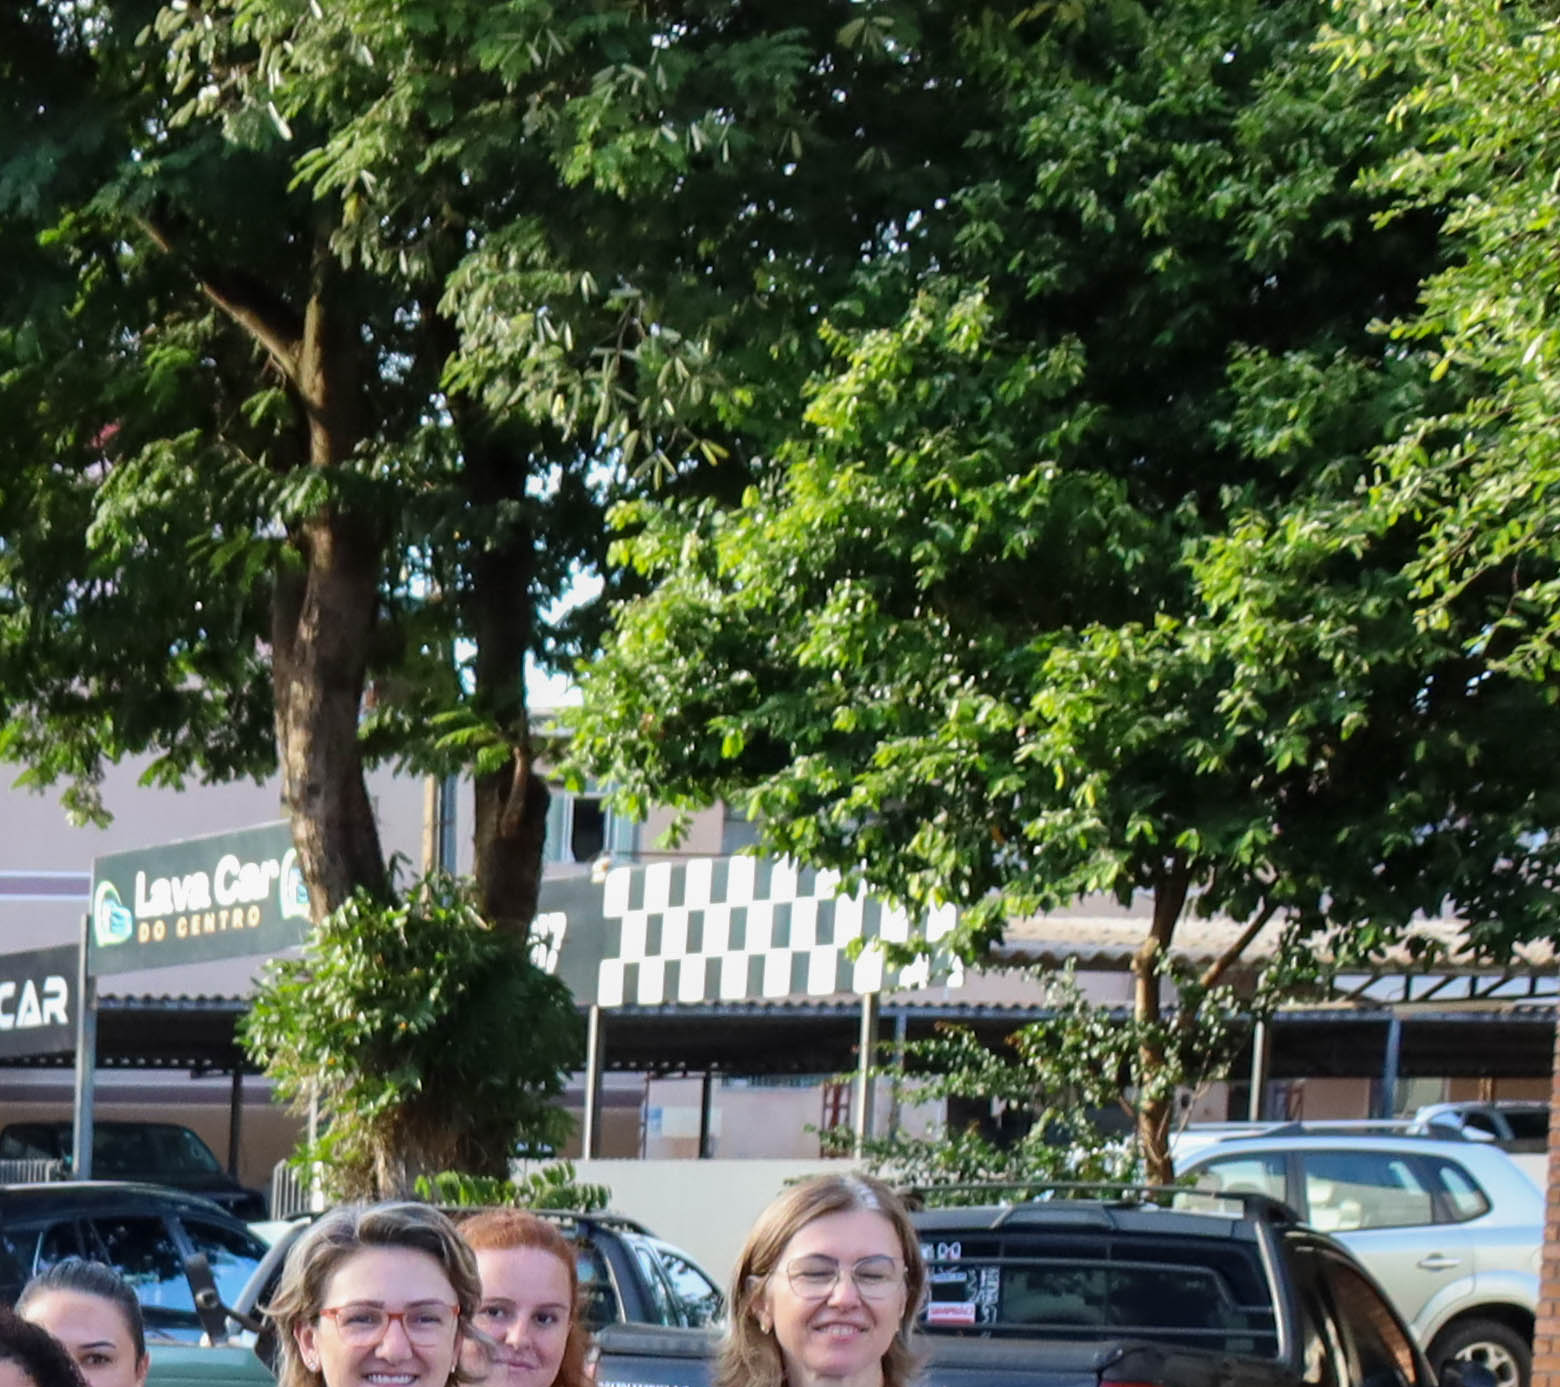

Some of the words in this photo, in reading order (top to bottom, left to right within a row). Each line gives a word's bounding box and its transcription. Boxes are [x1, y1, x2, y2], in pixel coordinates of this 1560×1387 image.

[134, 869, 212, 919] Lava
[213, 853, 280, 905] Car
[137, 917, 166, 943] DO
[175, 905, 261, 939] CENTRO
